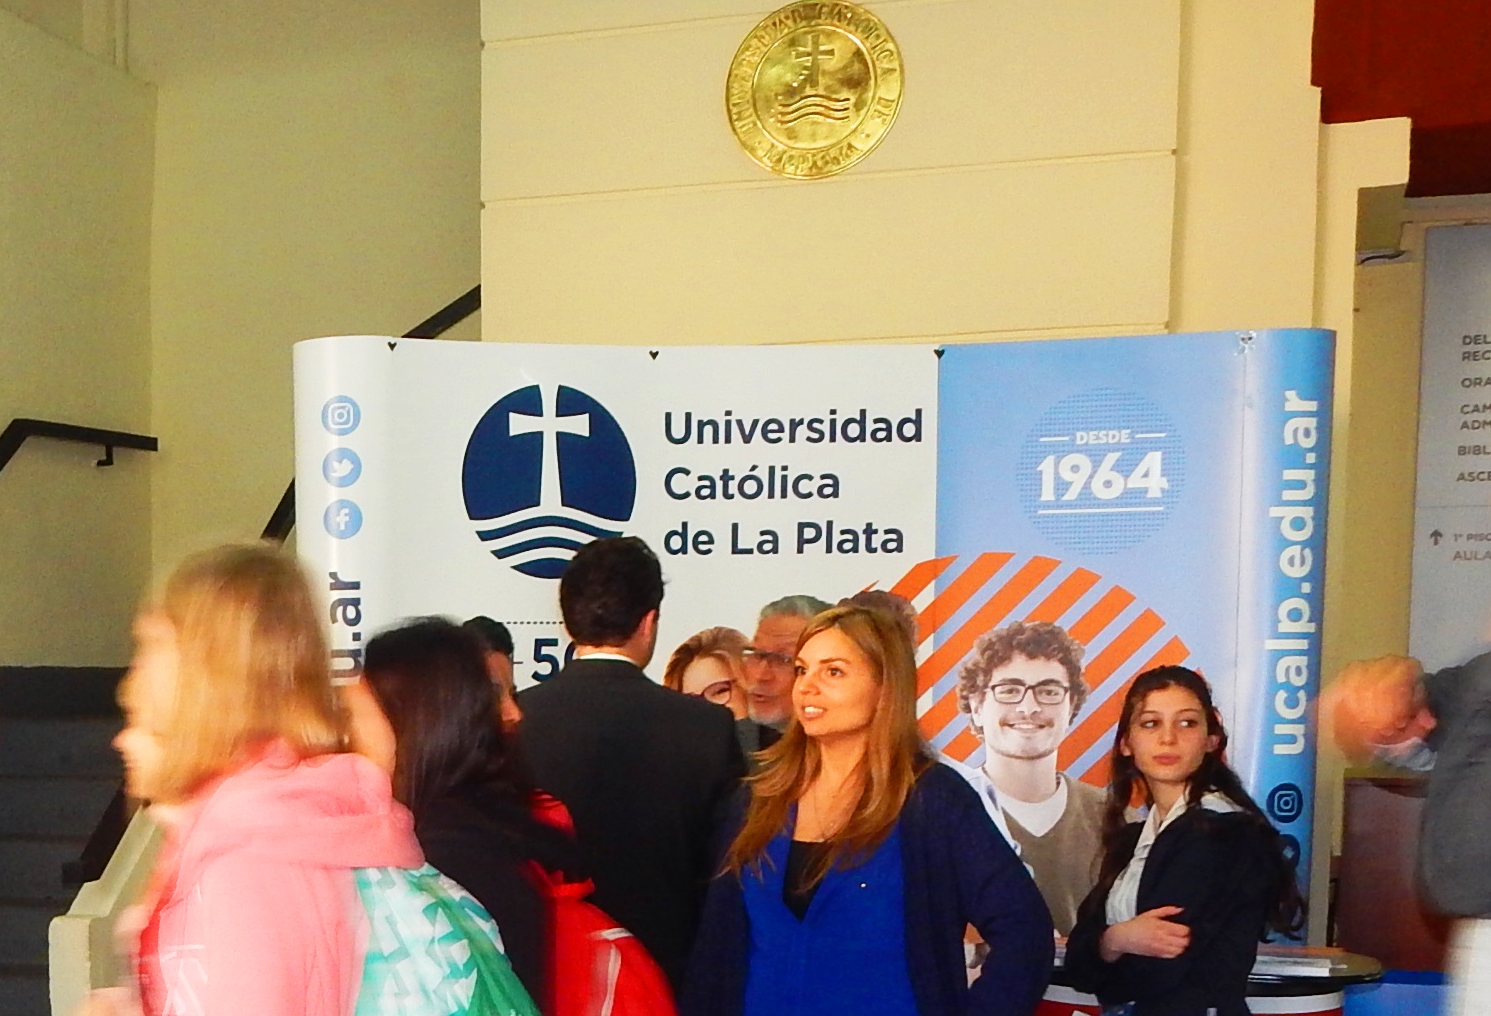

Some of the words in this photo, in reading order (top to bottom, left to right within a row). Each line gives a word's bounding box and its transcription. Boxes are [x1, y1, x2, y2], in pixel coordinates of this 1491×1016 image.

[664, 407, 923, 446] Universidad
[1075, 429, 1132, 445] DESDE
[664, 464, 841, 501] Católica
[1036, 450, 1169, 501] 1964
[663, 522, 714, 557] de
[731, 522, 780, 556] La
[797, 520, 905, 555] Plata
[1264, 389, 1320, 756] ucalp.edu.ar
